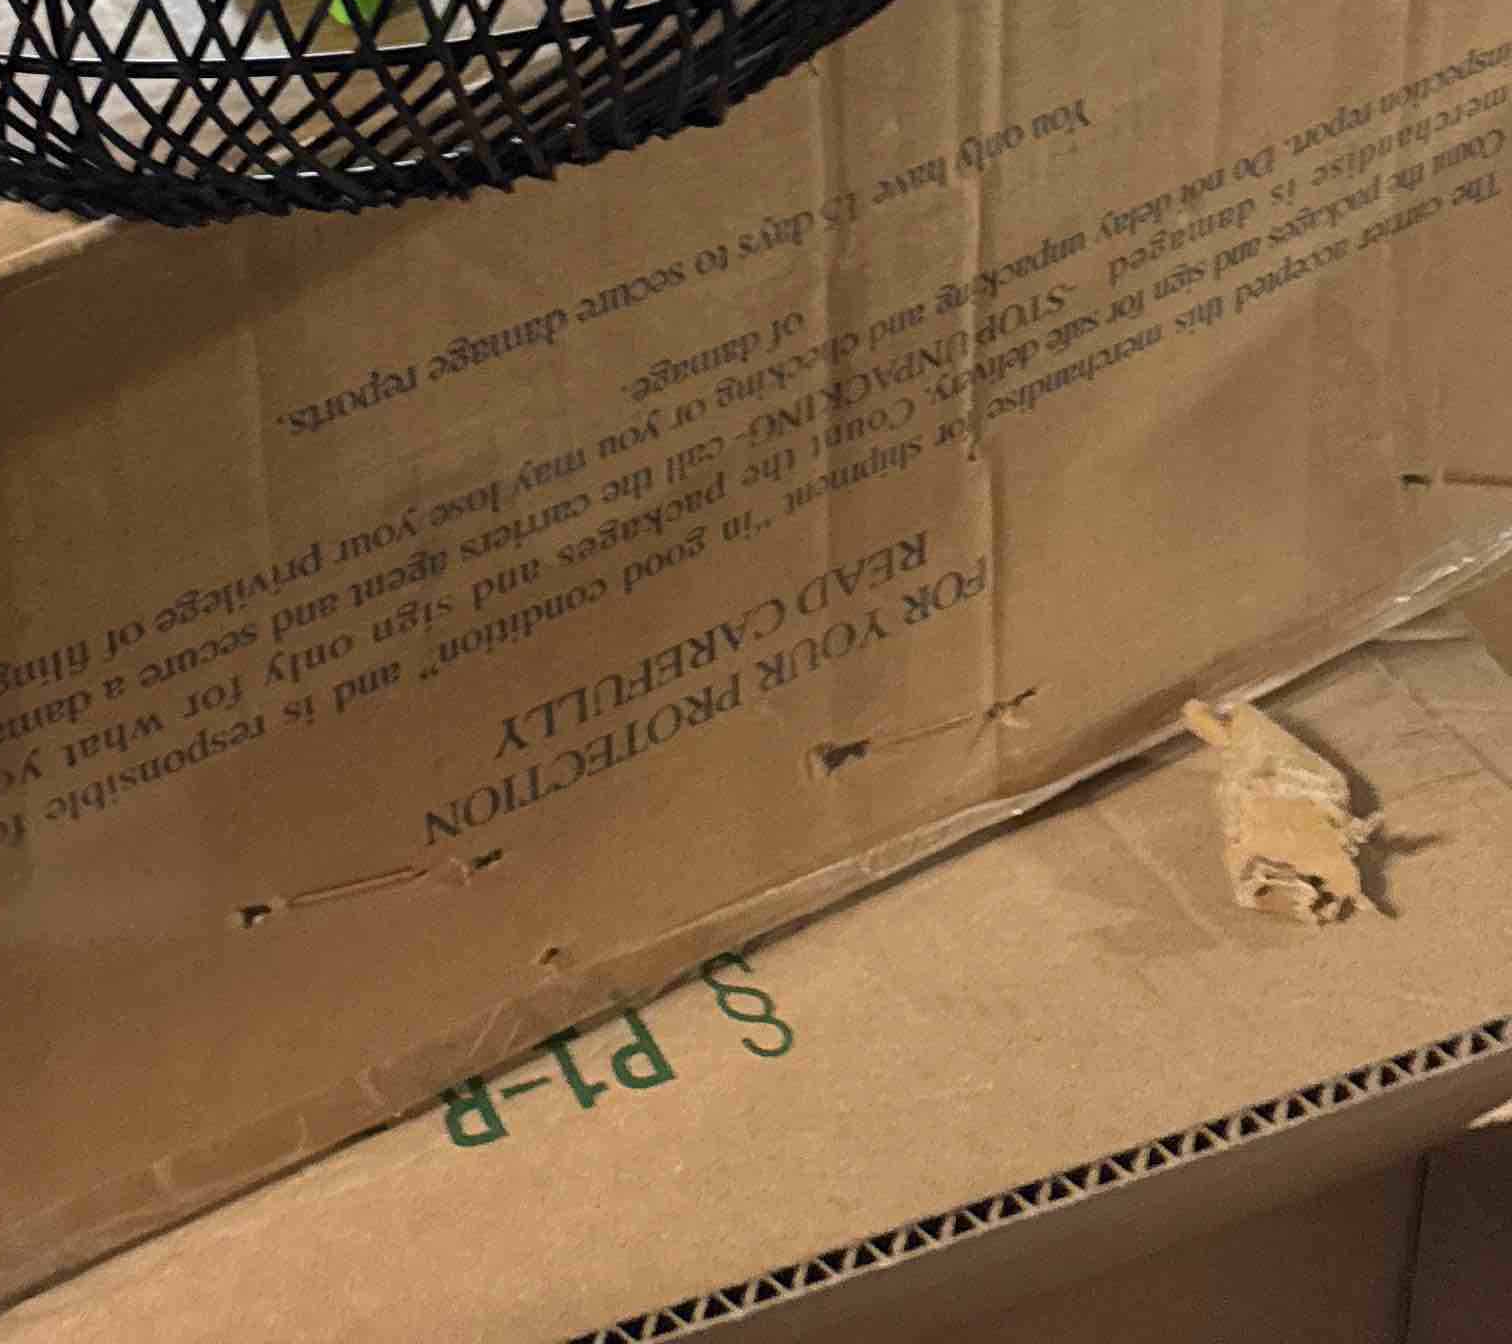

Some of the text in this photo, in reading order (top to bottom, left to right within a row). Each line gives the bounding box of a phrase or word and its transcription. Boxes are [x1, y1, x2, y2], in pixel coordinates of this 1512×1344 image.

[1031, 98, 1092, 144] You
[1285, 99, 1373, 157] report.
[1312, 86, 1512, 186] merchandise
[959, 127, 1024, 175] only
[1233, 146, 1274, 182] Do
[1430, 127, 1505, 174] Count
[873, 155, 945, 211] have
[1180, 169, 1225, 202] not
[1271, 177, 1296, 209] is
[1387, 162, 1425, 200] the
[1455, 172, 1501, 214] The
[738, 209, 813, 257] days
[1095, 189, 1172, 246] delay
[1268, 170, 1381, 256] packages
[1362, 189, 1441, 247] carrier
[695, 248, 729, 281] to
[1109, 198, 1255, 285] damaged
[1214, 234, 1262, 280] and
[576, 262, 684, 321] secure
[935, 232, 1086, 316] unpackng
[1152, 251, 1209, 302] sign
[1233, 239, 1349, 312] accepted
[868, 302, 926, 348] and
[1047, 311, 1099, 356] safe
[1104, 291, 1145, 326] for
[1176, 294, 1224, 334] this
[428, 307, 567, 381] damage
[622, 311, 806, 407] of damage.
[277, 364, 419, 435] reports.
[924, 340, 1041, 407] delivery.
[987, 325, 1162, 422] merchandise
[599, 410, 661, 456] you
[670, 397, 705, 431] or
[812, 396, 915, 449] Count
[511, 449, 586, 503] may
[602, 466, 653, 507] the
[667, 435, 724, 485] call
[742, 447, 796, 488] the
[781, 434, 922, 513] shipment
[429, 481, 500, 528] lose
[458, 492, 591, 566] carriers
[558, 468, 728, 573] packages
[334, 508, 417, 564] your
[623, 524, 705, 594] good
[156, 542, 321, 639] privilege
[350, 549, 448, 606] agent
[471, 559, 539, 611] and
[103, 619, 144, 656] of
[271, 592, 338, 639] and
[372, 596, 454, 643] sign
[139, 625, 257, 689] secure
[265, 634, 353, 688] only
[494, 531, 928, 758] READ CAREFULLY
[102, 678, 124, 699] a
[183, 676, 242, 721] for
[282, 696, 312, 725] is
[333, 660, 401, 713] and
[423, 556, 987, 846] FOR YOUR PROTECTION
[61, 713, 162, 769] what
[45, 714, 265, 825] responsible
[440, 1010, 676, 1148] P1-R
